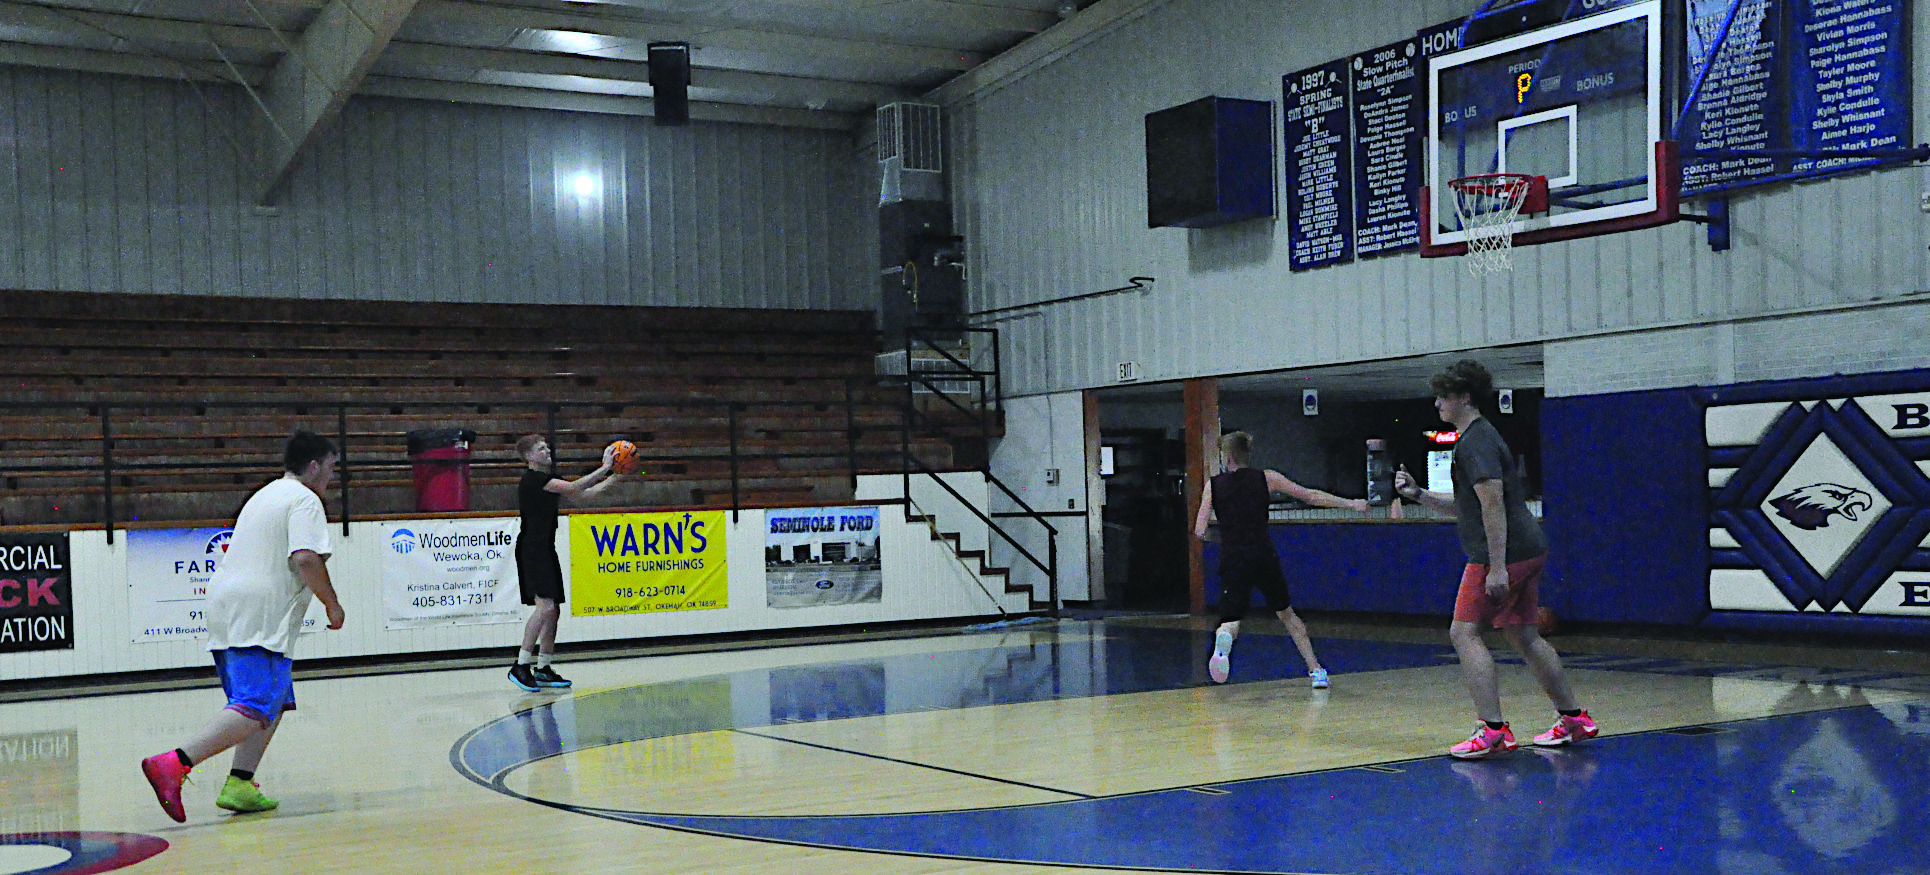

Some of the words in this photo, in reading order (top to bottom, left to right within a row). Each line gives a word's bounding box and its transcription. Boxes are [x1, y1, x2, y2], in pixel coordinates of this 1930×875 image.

[1847, 31, 1888, 48] Simpson
[1373, 49, 1396, 64] 2006
[1363, 65, 1384, 77] Slow
[1385, 57, 1409, 71] Pitch
[1508, 58, 1541, 74] PERIOD
[1846, 59, 1876, 72] Moore
[1301, 70, 1325, 91] 1997
[1576, 72, 1614, 92] BONUS
[1845, 71, 1880, 86] Murphy
[1300, 88, 1332, 106] SPRING
[1846, 85, 1874, 98] Smith
[1849, 123, 1876, 136] Harjo
[1841, 141, 1868, 151] Mark
[1870, 135, 1896, 148] Dean
[1721, 158, 1745, 170] Mark
[1119, 362, 1132, 379] EXIT
[770, 516, 835, 534] SEMINOLE
[839, 515, 874, 532] FORD
[418, 531, 512, 549] WoodmenLife
[590, 513, 708, 557] WARN'S
[0, 545, 63, 571] RCIAL
[433, 550, 483, 563] Wewoka,
[486, 549, 505, 560] Ok.
[446, 565, 490, 574] woodmen.org
[598, 562, 631, 574] HOME
[636, 558, 704, 572] FURNISHINGS
[0, 577, 61, 608] CK
[407, 582, 440, 592] Kristina
[615, 585, 686, 598] 918-623-0714
[412, 592, 494, 608] 405-831-7311
[0, 615, 66, 643] ATION
[144, 628, 161, 637] 411
[164, 627, 175, 635] W
